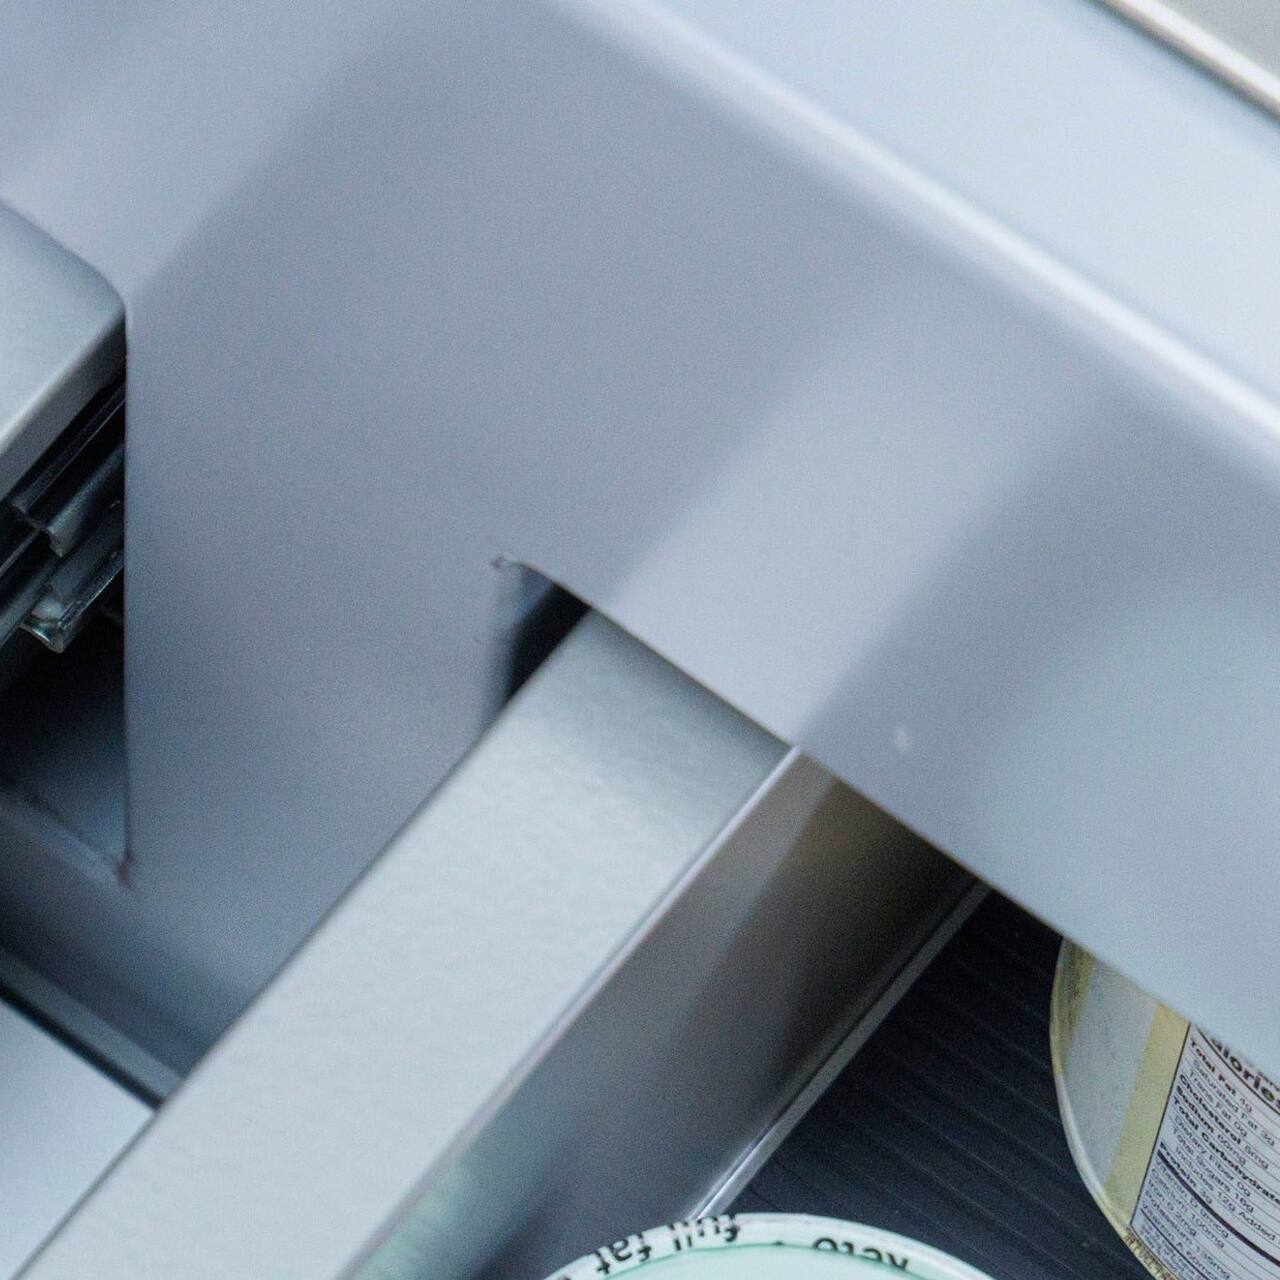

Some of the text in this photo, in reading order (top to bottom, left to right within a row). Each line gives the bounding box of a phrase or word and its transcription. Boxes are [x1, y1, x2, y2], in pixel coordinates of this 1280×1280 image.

[1191, 1039, 1214, 1073] Total
[1218, 1075, 1235, 1094] Fat
[1173, 1095, 1197, 1131] Total
[1176, 1084, 1213, 1133] Sodium
[1180, 1073, 1240, 1143] Cholesterol
